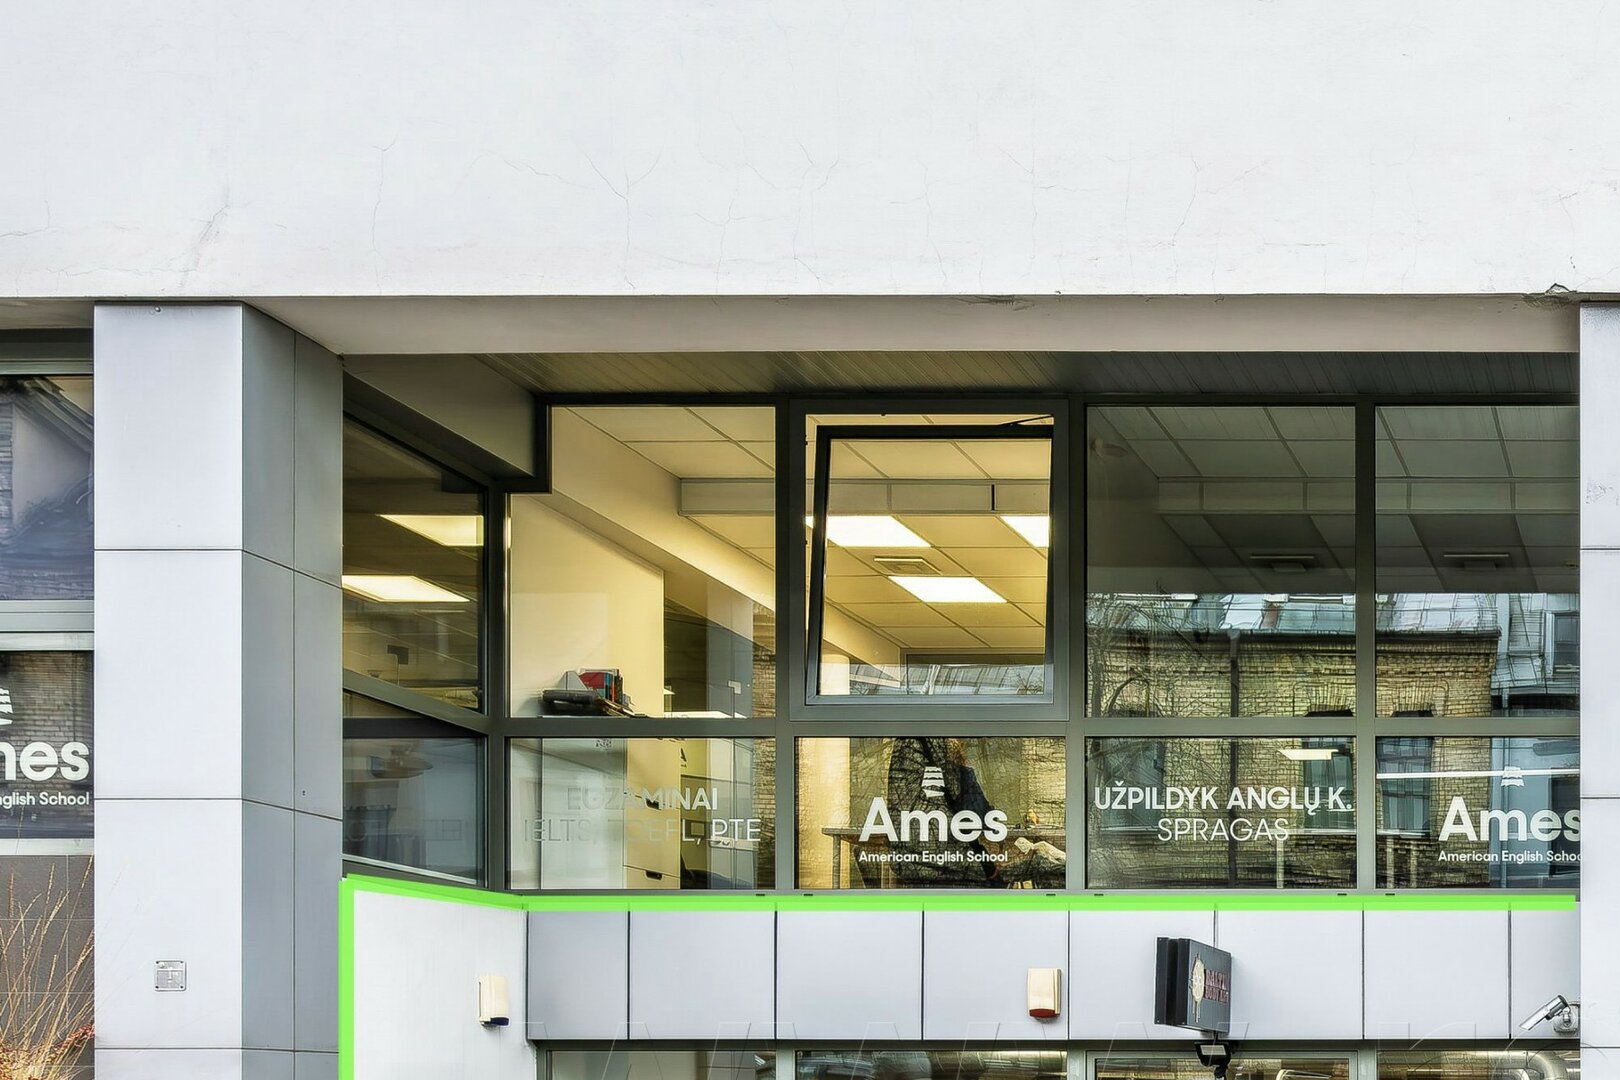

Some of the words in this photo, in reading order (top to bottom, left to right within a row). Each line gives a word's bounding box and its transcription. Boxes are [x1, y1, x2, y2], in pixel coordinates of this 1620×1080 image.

[0, 792, 36, 809] glish
[39, 792, 90, 806] School
[566, 786, 718, 811] EGZAMINAI
[1094, 780, 1219, 811] UŽPILDYK
[1226, 786, 1321, 817] ANGLŲ
[1327, 786, 1353, 811] K.
[711, 818, 762, 842] PTE
[858, 796, 1009, 843] Ames
[1157, 817, 1290, 843] SPRAGAS
[1438, 796, 1581, 842] Ames
[858, 850, 920, 864] American
[921, 850, 964, 867] English
[966, 850, 1009, 864] School
[1438, 850, 1499, 863] American
[1501, 850, 1543, 865] English
